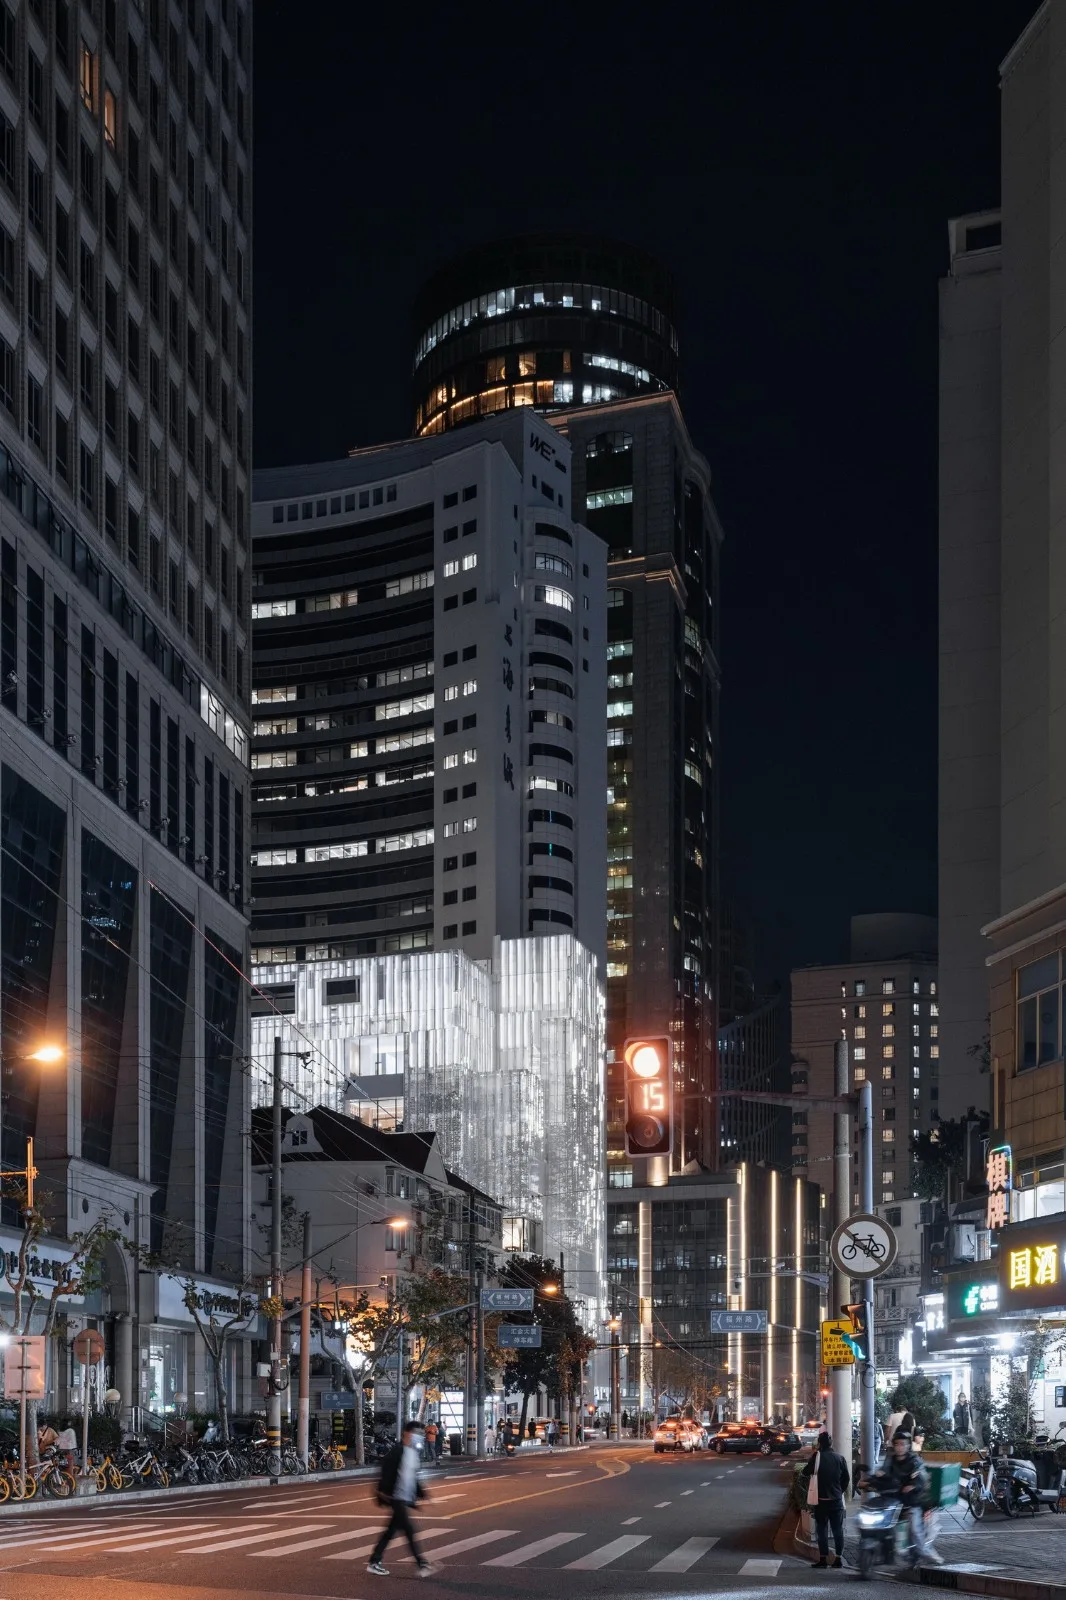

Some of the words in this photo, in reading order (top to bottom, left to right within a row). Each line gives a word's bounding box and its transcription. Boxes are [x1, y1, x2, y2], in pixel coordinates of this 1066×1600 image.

[642, 1082, 665, 1110] 15
[986, 1152, 1008, 1229] 棋牌
[1010, 1244, 1058, 1290] 国酒
[726, 1315, 753, 1323] 福州路
